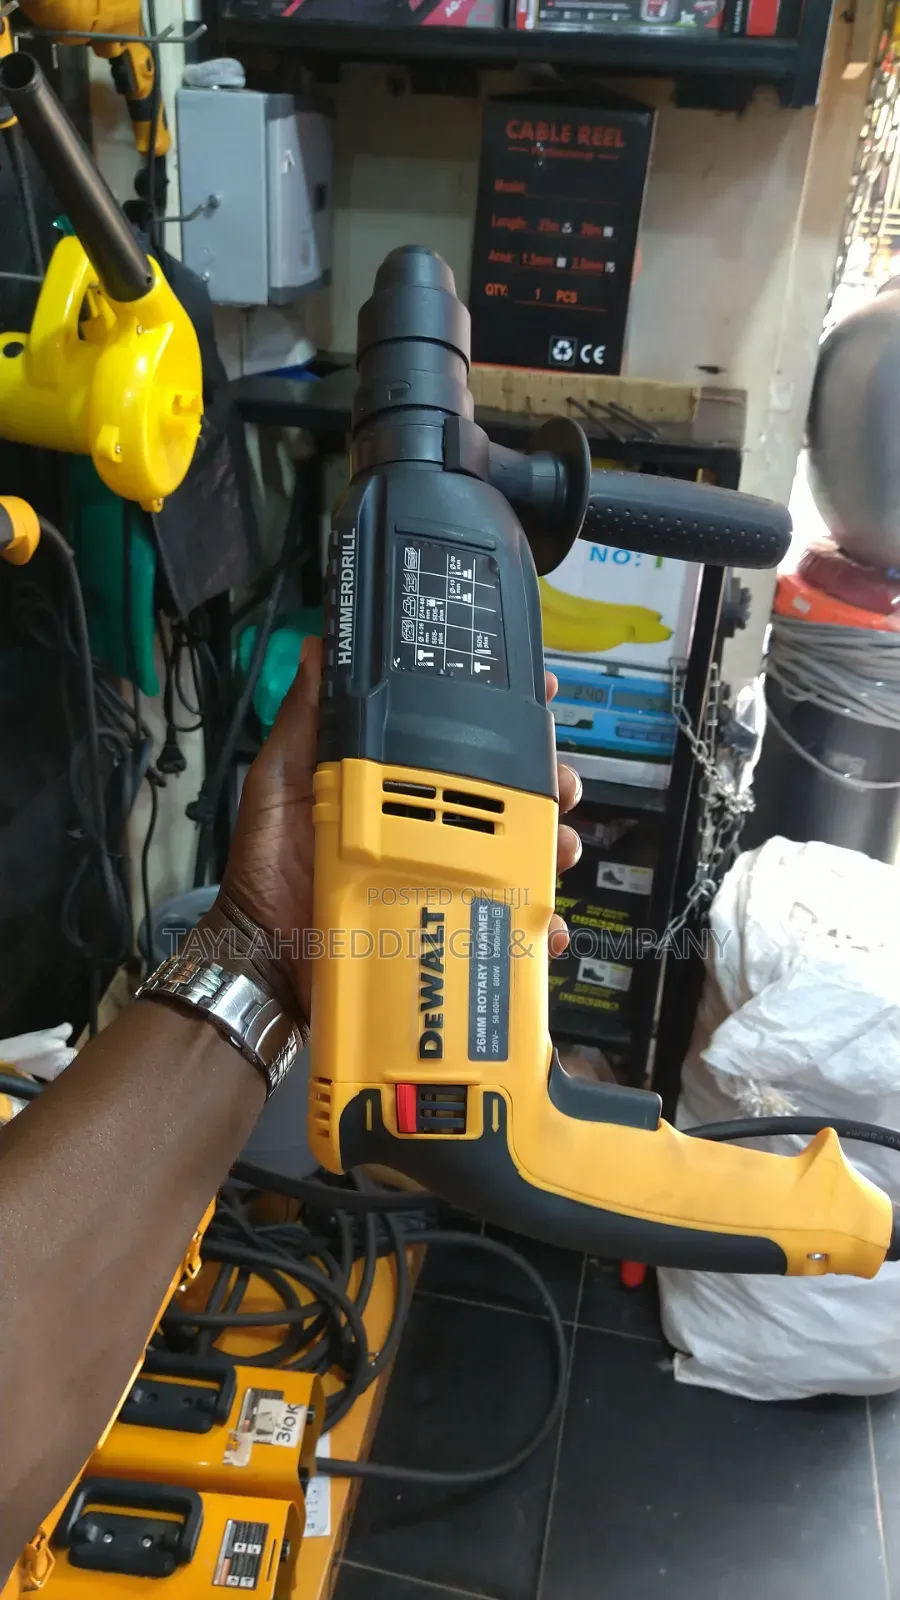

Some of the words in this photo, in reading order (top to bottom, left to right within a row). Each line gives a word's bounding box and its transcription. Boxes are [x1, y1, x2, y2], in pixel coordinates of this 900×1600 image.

[506, 119, 572, 143] CABLE
[577, 125, 624, 147] REEL
[485, 283, 509, 296] QTY:
[535, 287, 542, 300] 1
[590, 546, 642, 567] NO:
[338, 528, 356, 665] HAMMERDRILL
[478, 904, 488, 960] HAMMER
[477, 964, 487, 1013] ROTARY
[477, 1017, 487, 1053] 26MM
